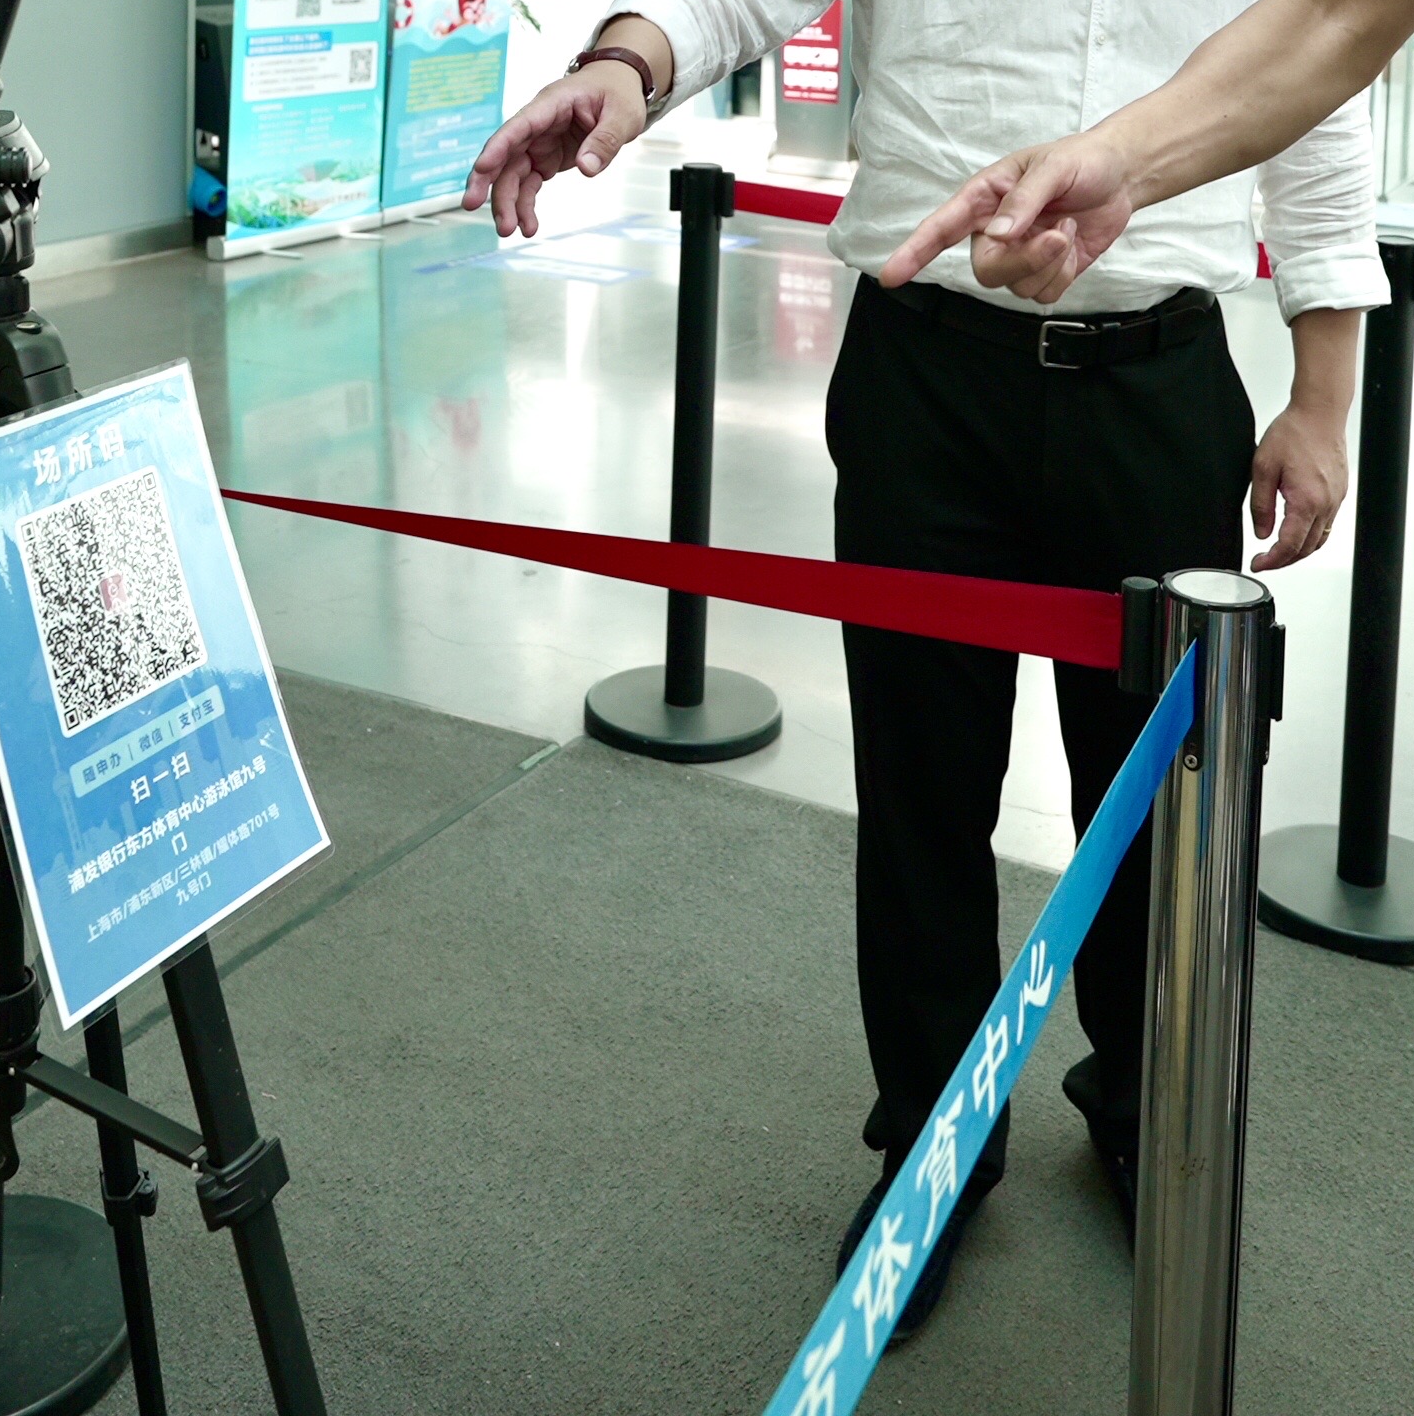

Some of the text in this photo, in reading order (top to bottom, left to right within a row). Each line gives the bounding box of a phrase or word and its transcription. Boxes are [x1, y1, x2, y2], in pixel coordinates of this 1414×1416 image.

[33, 422, 125, 487] 场所码
[138, 728, 163, 752] 微信
[178, 698, 215, 730] 支付宝
[130, 751, 191, 804] 扫一扫
[67, 754, 267, 894] 浦发银行东方体育中心游泳馆九号
[171, 831, 188, 856] 门
[175, 871, 212, 906] 九号门
